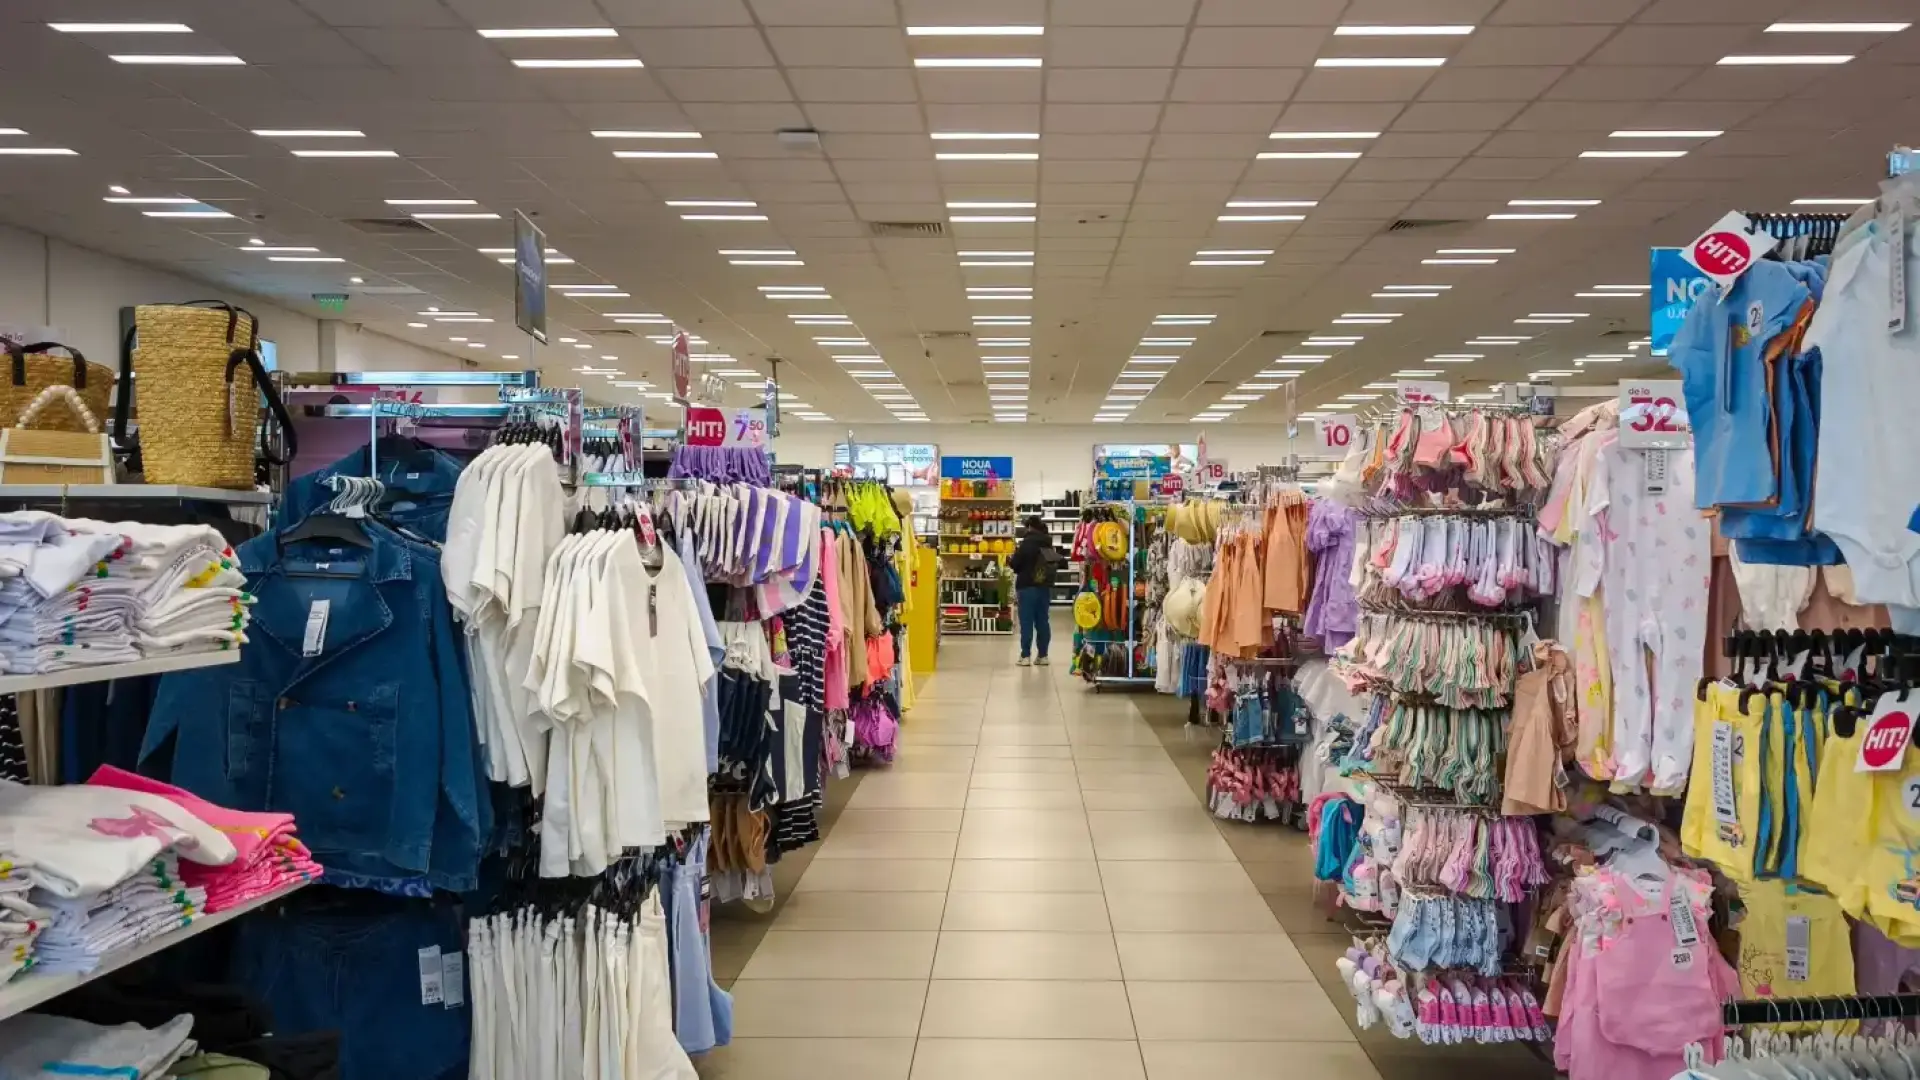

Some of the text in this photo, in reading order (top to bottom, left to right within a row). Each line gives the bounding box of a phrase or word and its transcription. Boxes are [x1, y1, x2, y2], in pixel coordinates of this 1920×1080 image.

[1699, 236, 1747, 271] HIT!
[1628, 387, 1650, 395] de la
[688, 421, 723, 438] HIT!
[734, 419, 765, 441] 7 50
[1322, 424, 1350, 447] 10
[1208, 464, 1224, 478] 18
[1734, 735, 1744, 757] 2
[1866, 726, 1906, 750] HIT!
